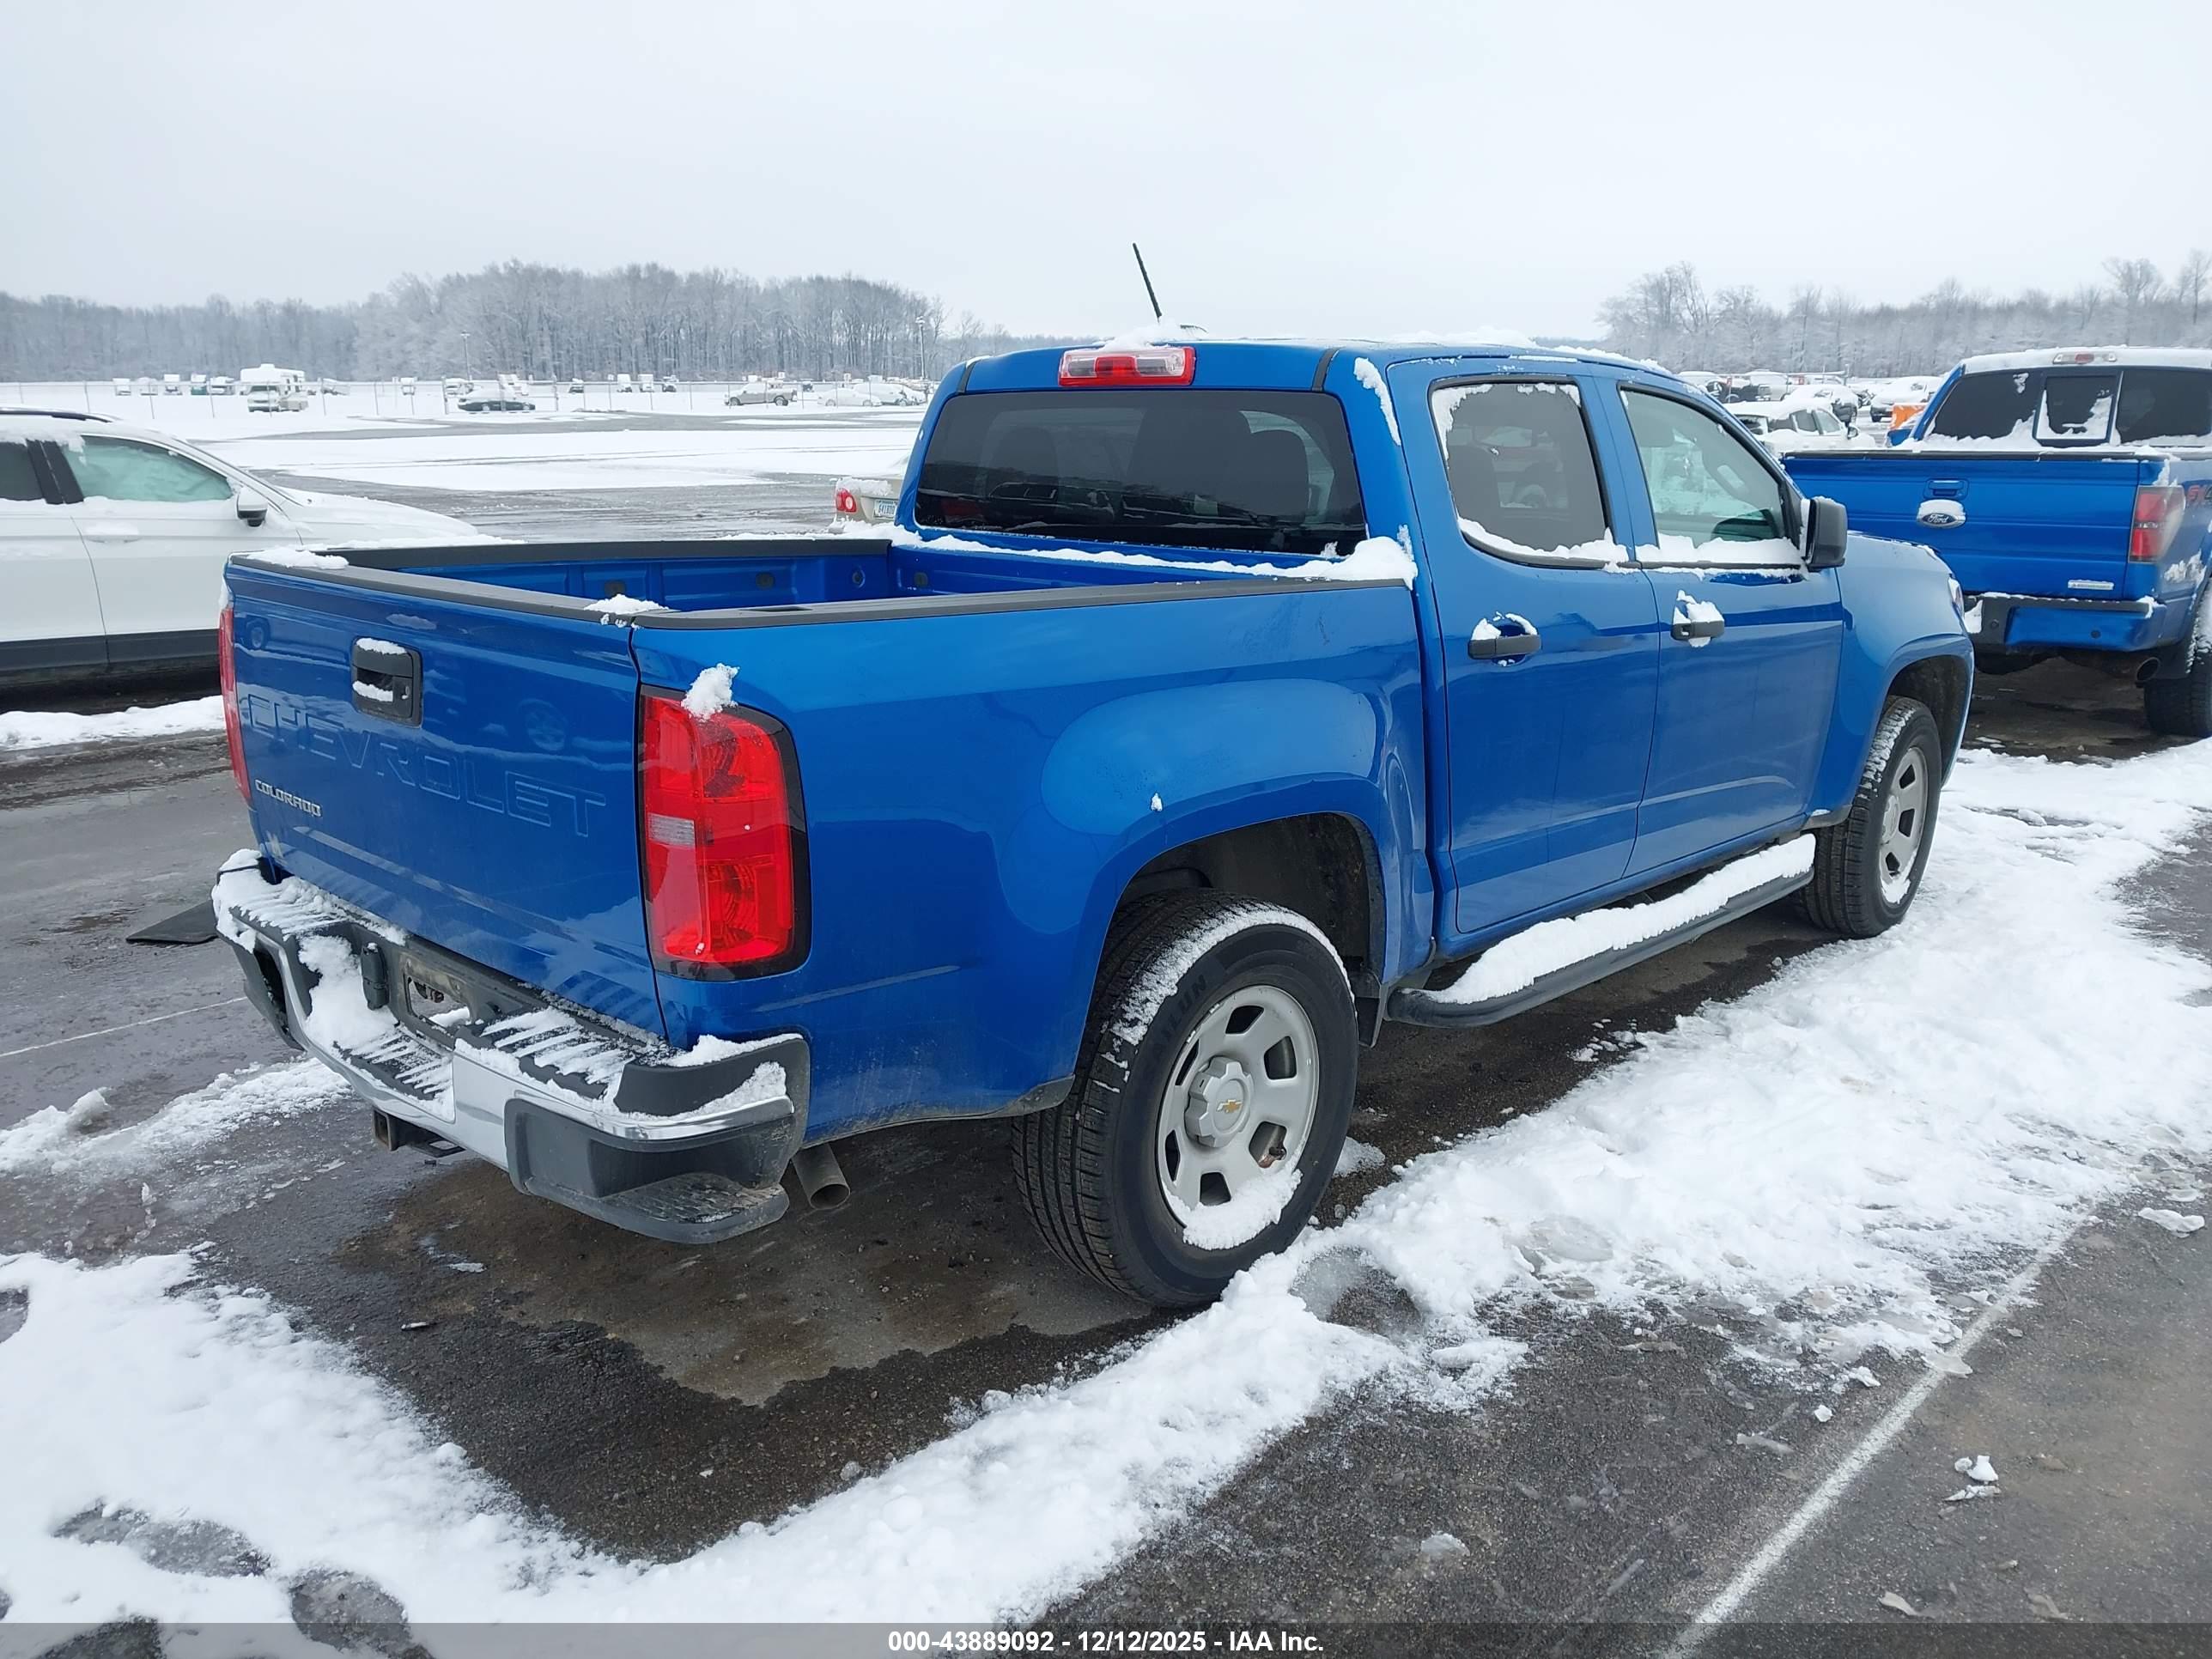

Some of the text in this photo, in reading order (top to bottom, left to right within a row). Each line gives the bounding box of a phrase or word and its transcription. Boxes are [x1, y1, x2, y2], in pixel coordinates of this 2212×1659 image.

[1927, 514, 1950, 523] Ford
[248, 693, 606, 838] CHEVROLET
[255, 779, 322, 817] COLORADO
